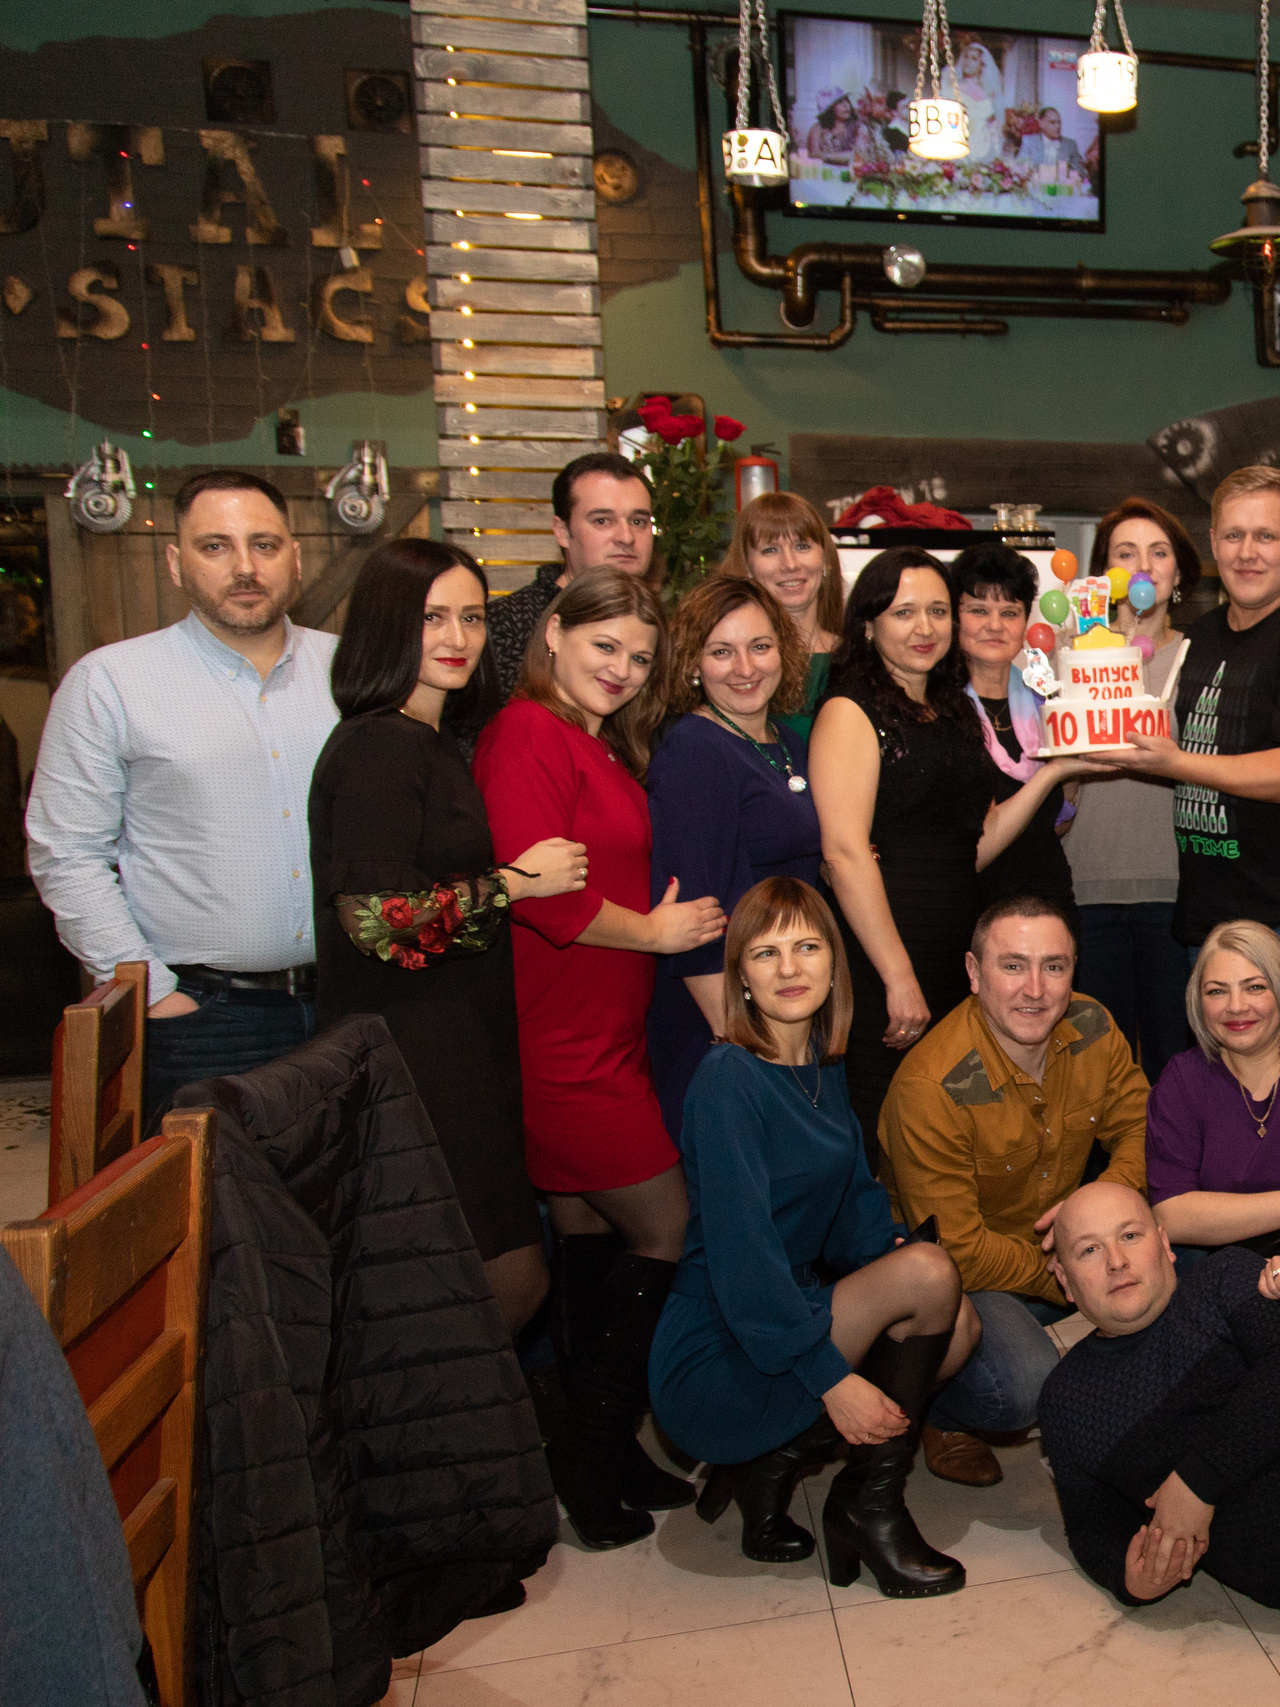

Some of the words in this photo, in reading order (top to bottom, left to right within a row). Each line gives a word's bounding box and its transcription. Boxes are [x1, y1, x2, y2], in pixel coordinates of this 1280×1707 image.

[1071, 664, 1139, 684] ВЫПУСК
[1046, 711, 1078, 747] 10
[1189, 835, 1241, 859] TIME
